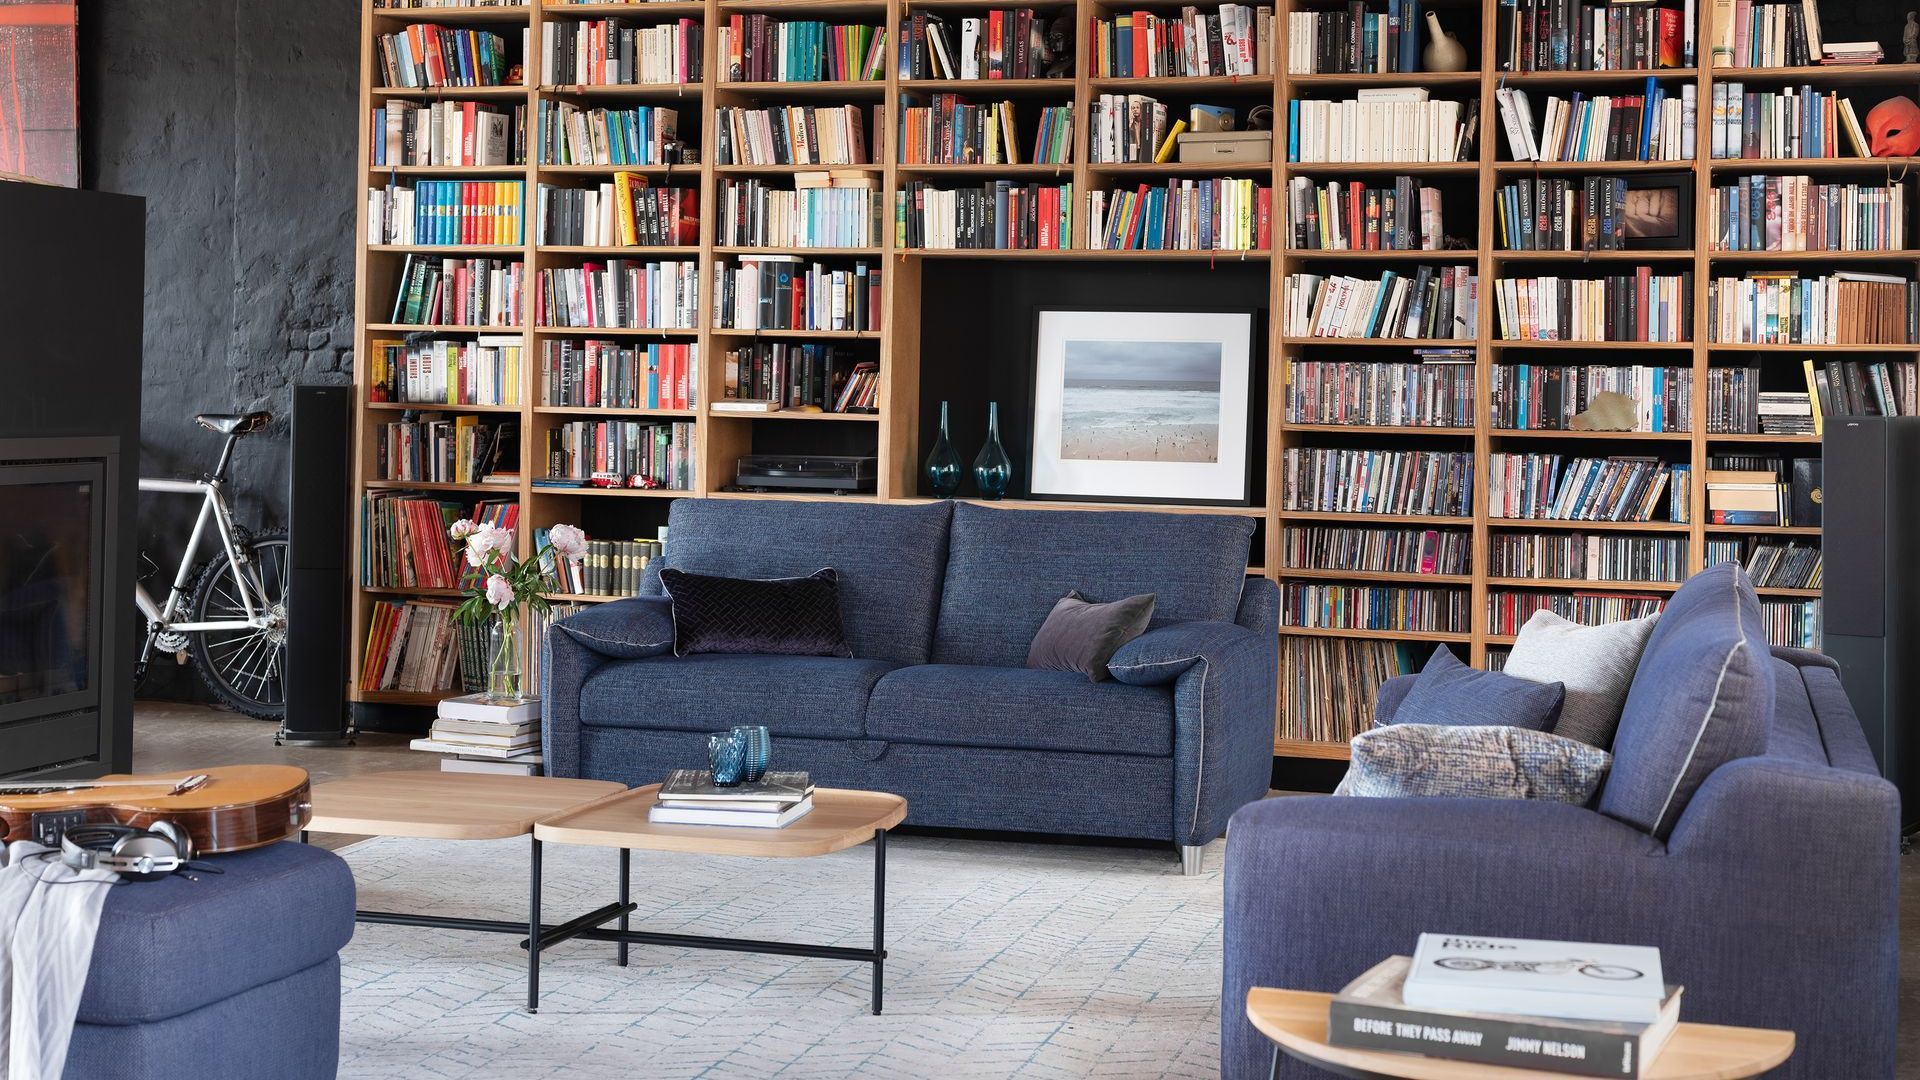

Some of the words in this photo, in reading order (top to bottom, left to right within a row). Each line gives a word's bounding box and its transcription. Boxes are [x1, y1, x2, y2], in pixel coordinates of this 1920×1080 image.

[965, 20, 972, 32] 2
[797, 122, 805, 150] Medicus
[1739, 186, 1747, 219] 1977
[1767, 183, 1776, 220] 1983
[416, 264, 425, 294] DETEKTIV
[1339, 285, 1349, 307] KOLYMA
[423, 355, 431, 374] SATORI
[561, 343, 571, 362] EXIT
[561, 367, 571, 387] LAST
[1353, 1017, 1393, 1036] BEFORE
[1395, 1022, 1422, 1040] THEY
[1422, 1026, 1452, 1043] PASS
[1452, 1029, 1483, 1046] AWAY
[1505, 1036, 1541, 1054] JIMMY
[1542, 1040, 1586, 1060] NELSON
